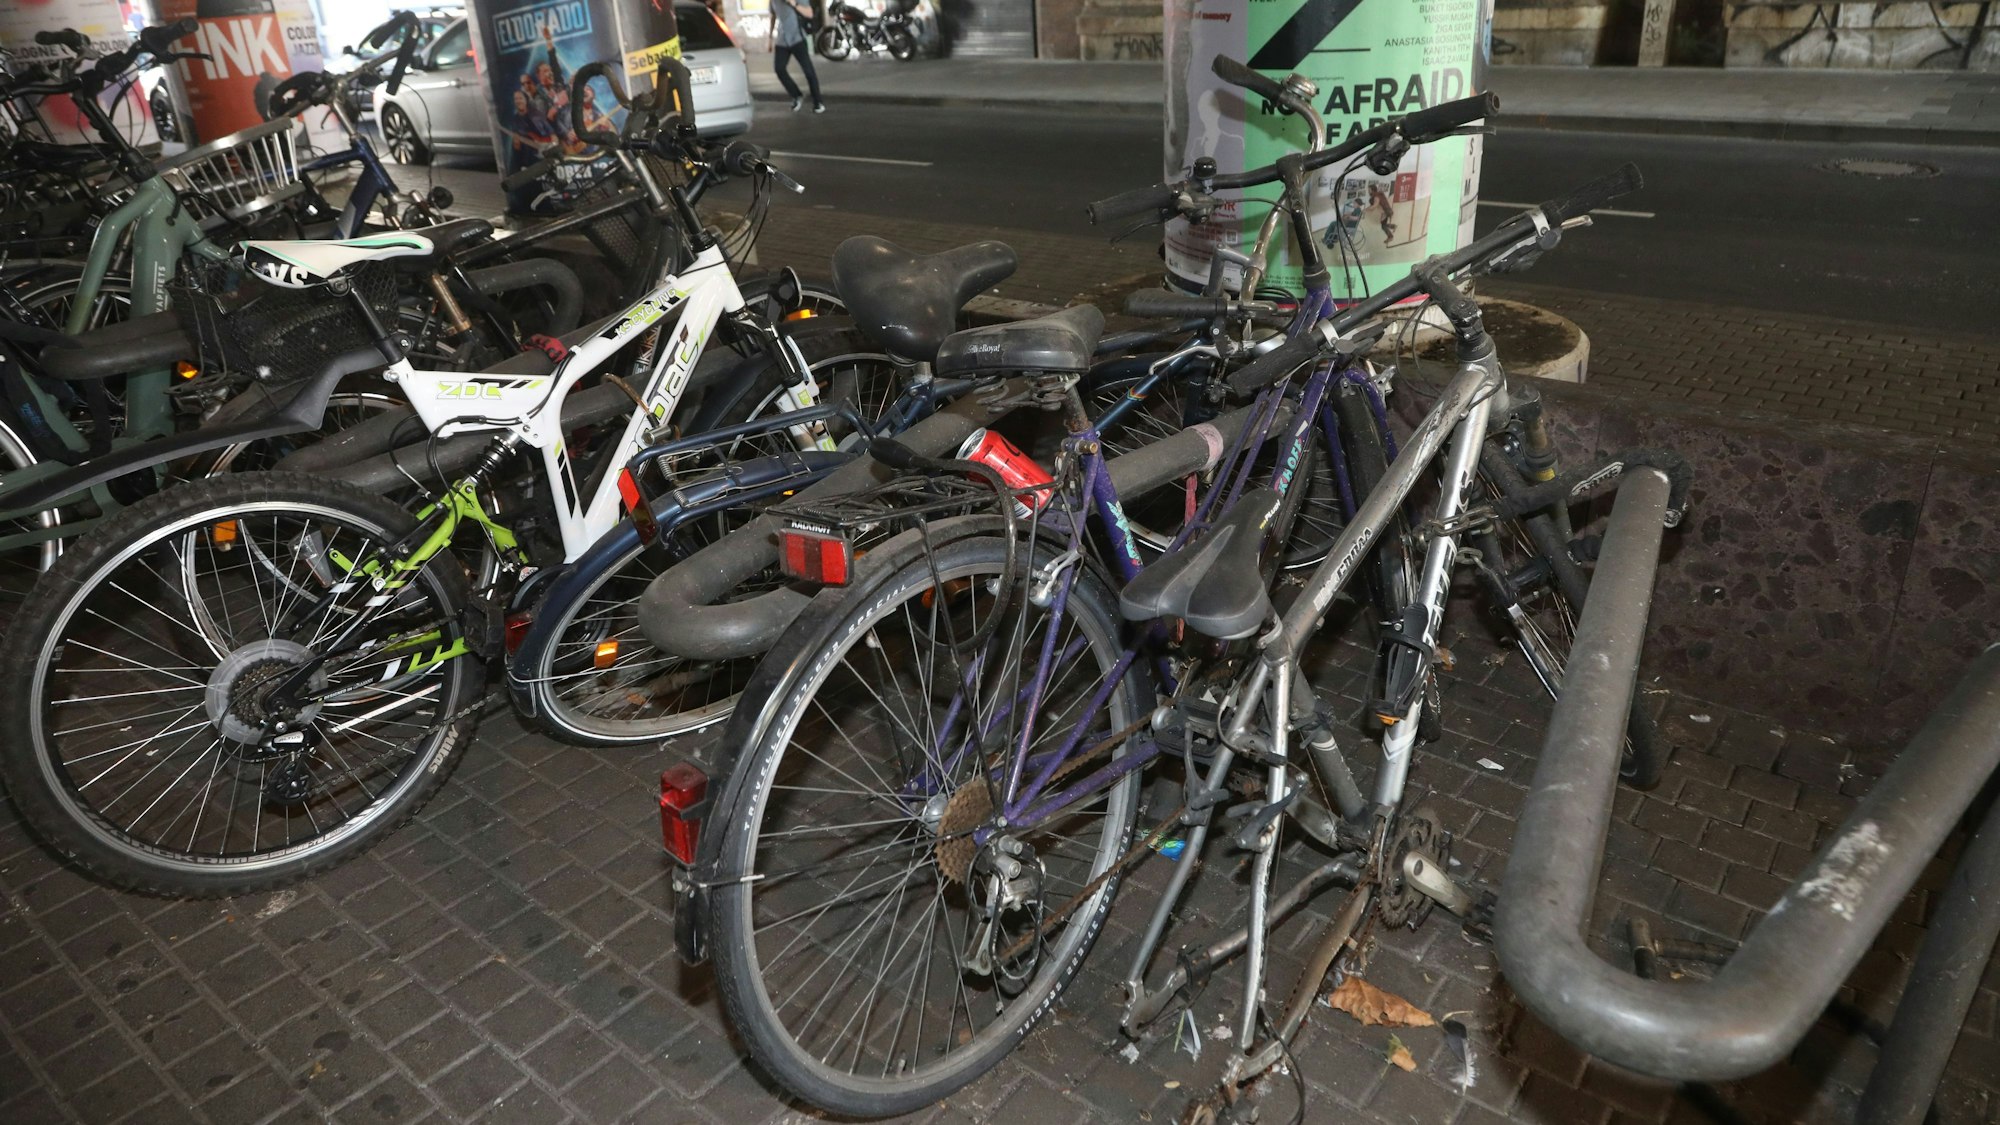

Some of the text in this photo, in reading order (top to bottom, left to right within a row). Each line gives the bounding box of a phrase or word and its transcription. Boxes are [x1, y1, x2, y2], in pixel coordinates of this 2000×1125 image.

[497, 2, 584, 46] ELDORADO
[1384, 36, 1433, 47] ANASTASIA
[1323, 67, 1464, 115] AFRAID
[631, 287, 677, 326] CYCLING
[436, 380, 503, 401] ZDC
[848, 584, 907, 634] SPECIAL
[428, 724, 459, 775] Mitas
[744, 714, 790, 831] TRAVELLER
[1016, 981, 1063, 1036] SPECIAL
